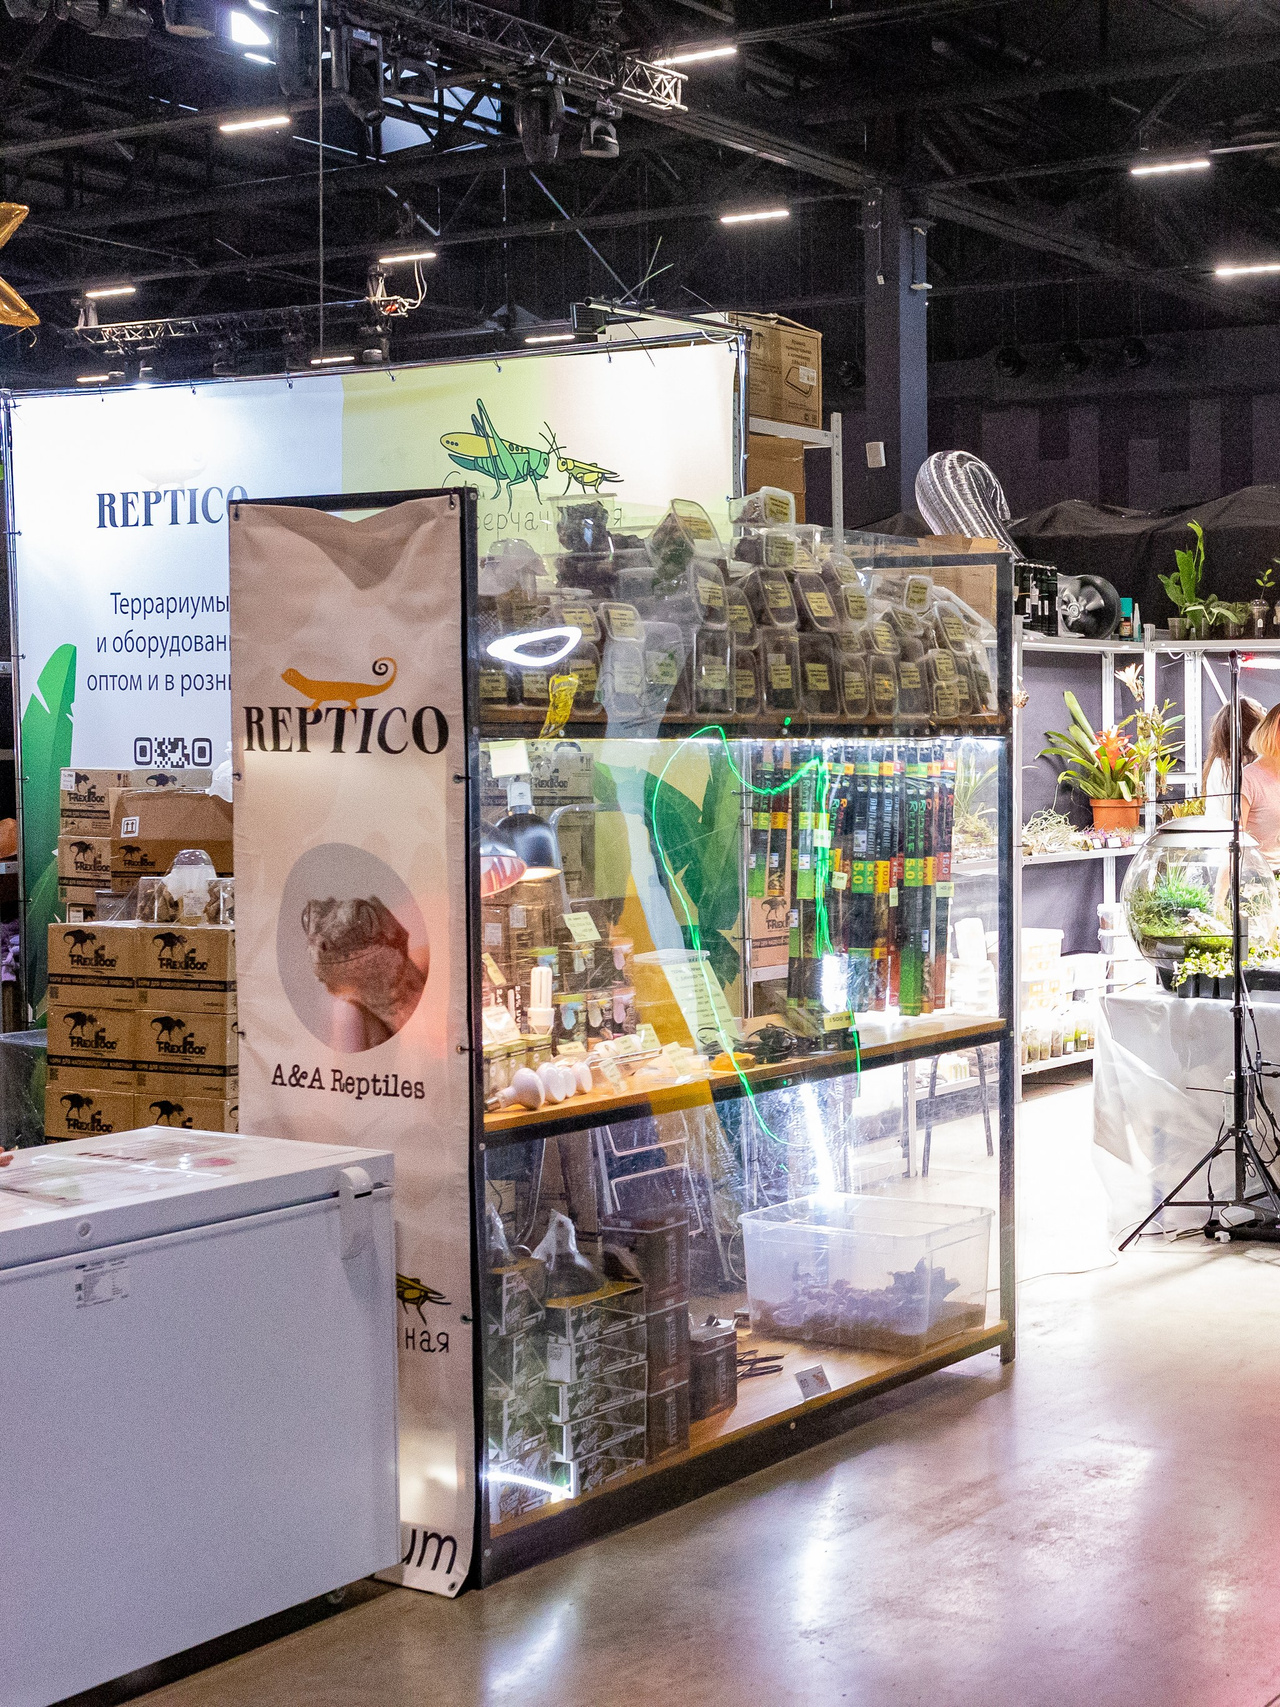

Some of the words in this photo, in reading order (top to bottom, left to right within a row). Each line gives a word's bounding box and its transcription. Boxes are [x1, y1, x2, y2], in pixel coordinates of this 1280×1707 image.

[110, 592, 230, 620] Террариумы
[97, 636, 107, 653] и
[86, 674, 143, 691] оптом
[148, 674, 159, 691] и
[165, 674, 175, 691] в
[243, 705, 450, 755] REPTICO
[853, 862, 865, 885] 5.0
[906, 858, 916, 880] 5.0
[271, 1063, 325, 1090] A&A
[330, 1068, 426, 1100] Reptiles
